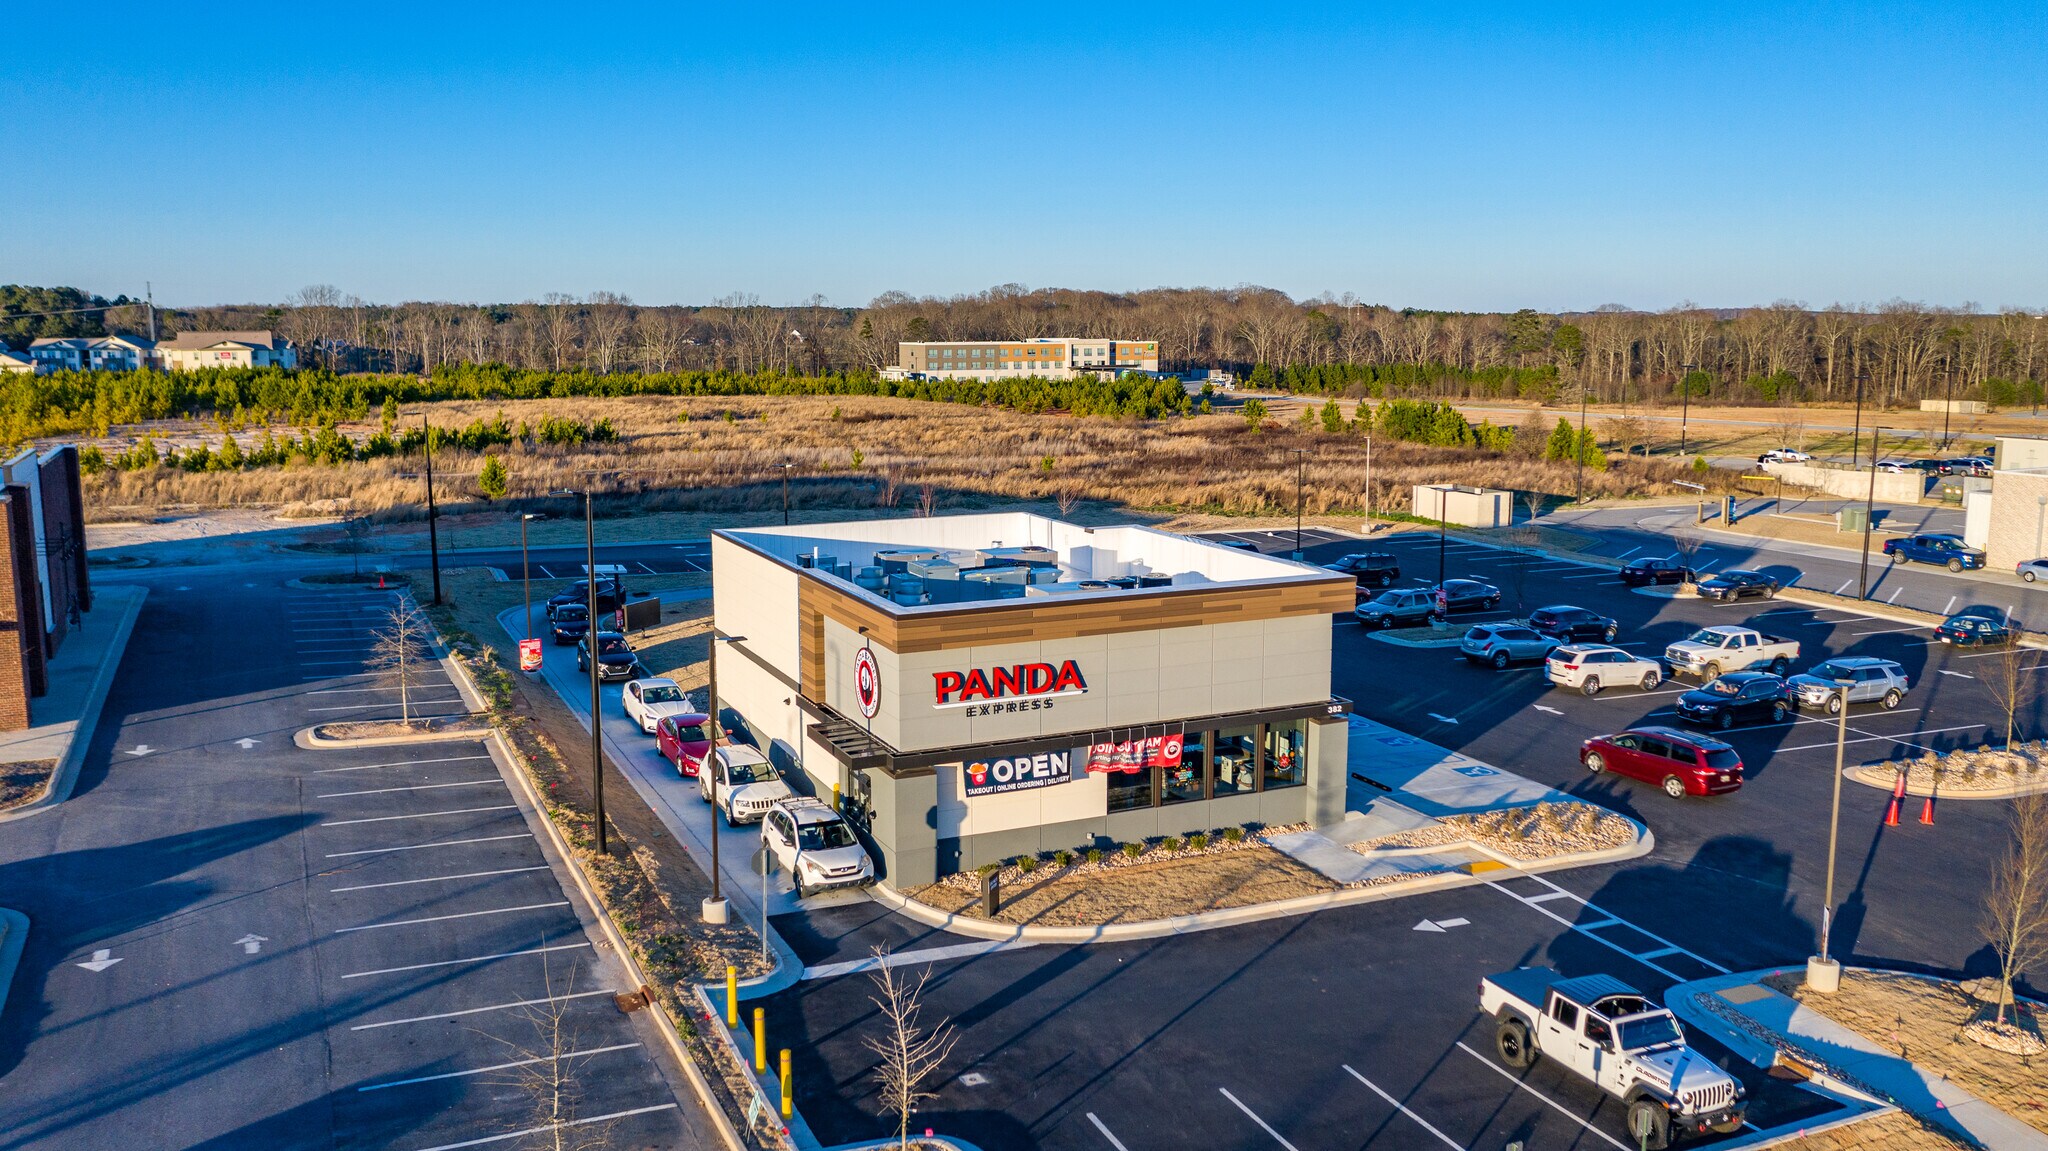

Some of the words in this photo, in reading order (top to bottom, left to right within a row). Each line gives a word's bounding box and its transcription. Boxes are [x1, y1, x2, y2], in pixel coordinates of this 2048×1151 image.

[932, 660, 1086, 704] PANDA
[966, 698, 1054, 717] EXPRESS
[1327, 705, 1343, 714] 382
[992, 752, 1069, 782] OPEN
[967, 785, 994, 795] TAKEOUT
[997, 783, 1017, 793] ONLINE
[1017, 780, 1044, 789] ORDERING
[1047, 775, 1070, 785] DELIVERY
